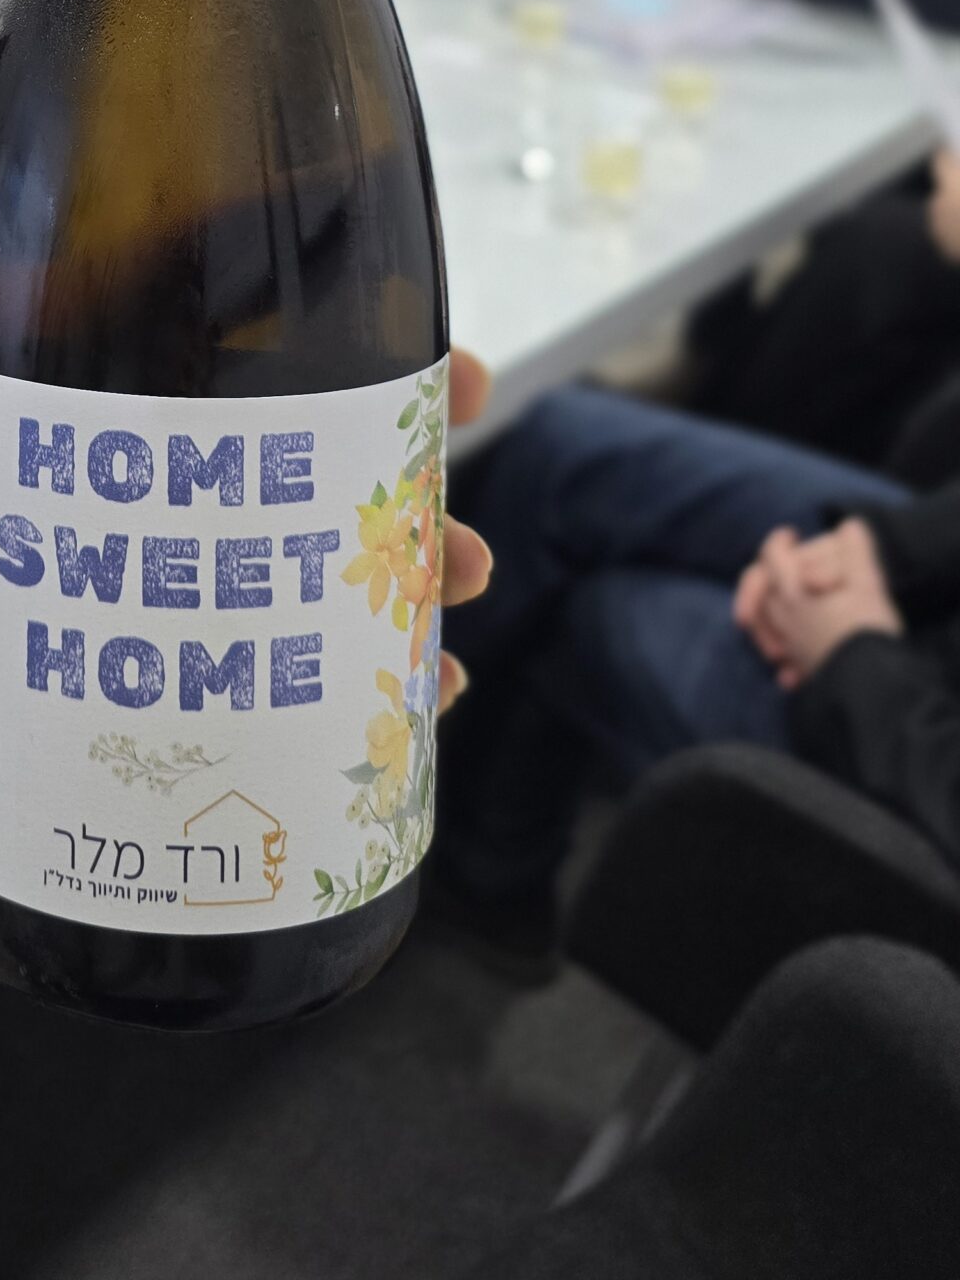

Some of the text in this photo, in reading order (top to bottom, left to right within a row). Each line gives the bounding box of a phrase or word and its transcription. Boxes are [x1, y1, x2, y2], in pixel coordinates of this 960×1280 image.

[18, 417, 315, 507] HOME
[26, 620, 323, 712] HOME
[53, 823, 240, 884] ורד מלר
[87, 880, 131, 900] ותיווך
[137, 888, 178, 904] שיווק
